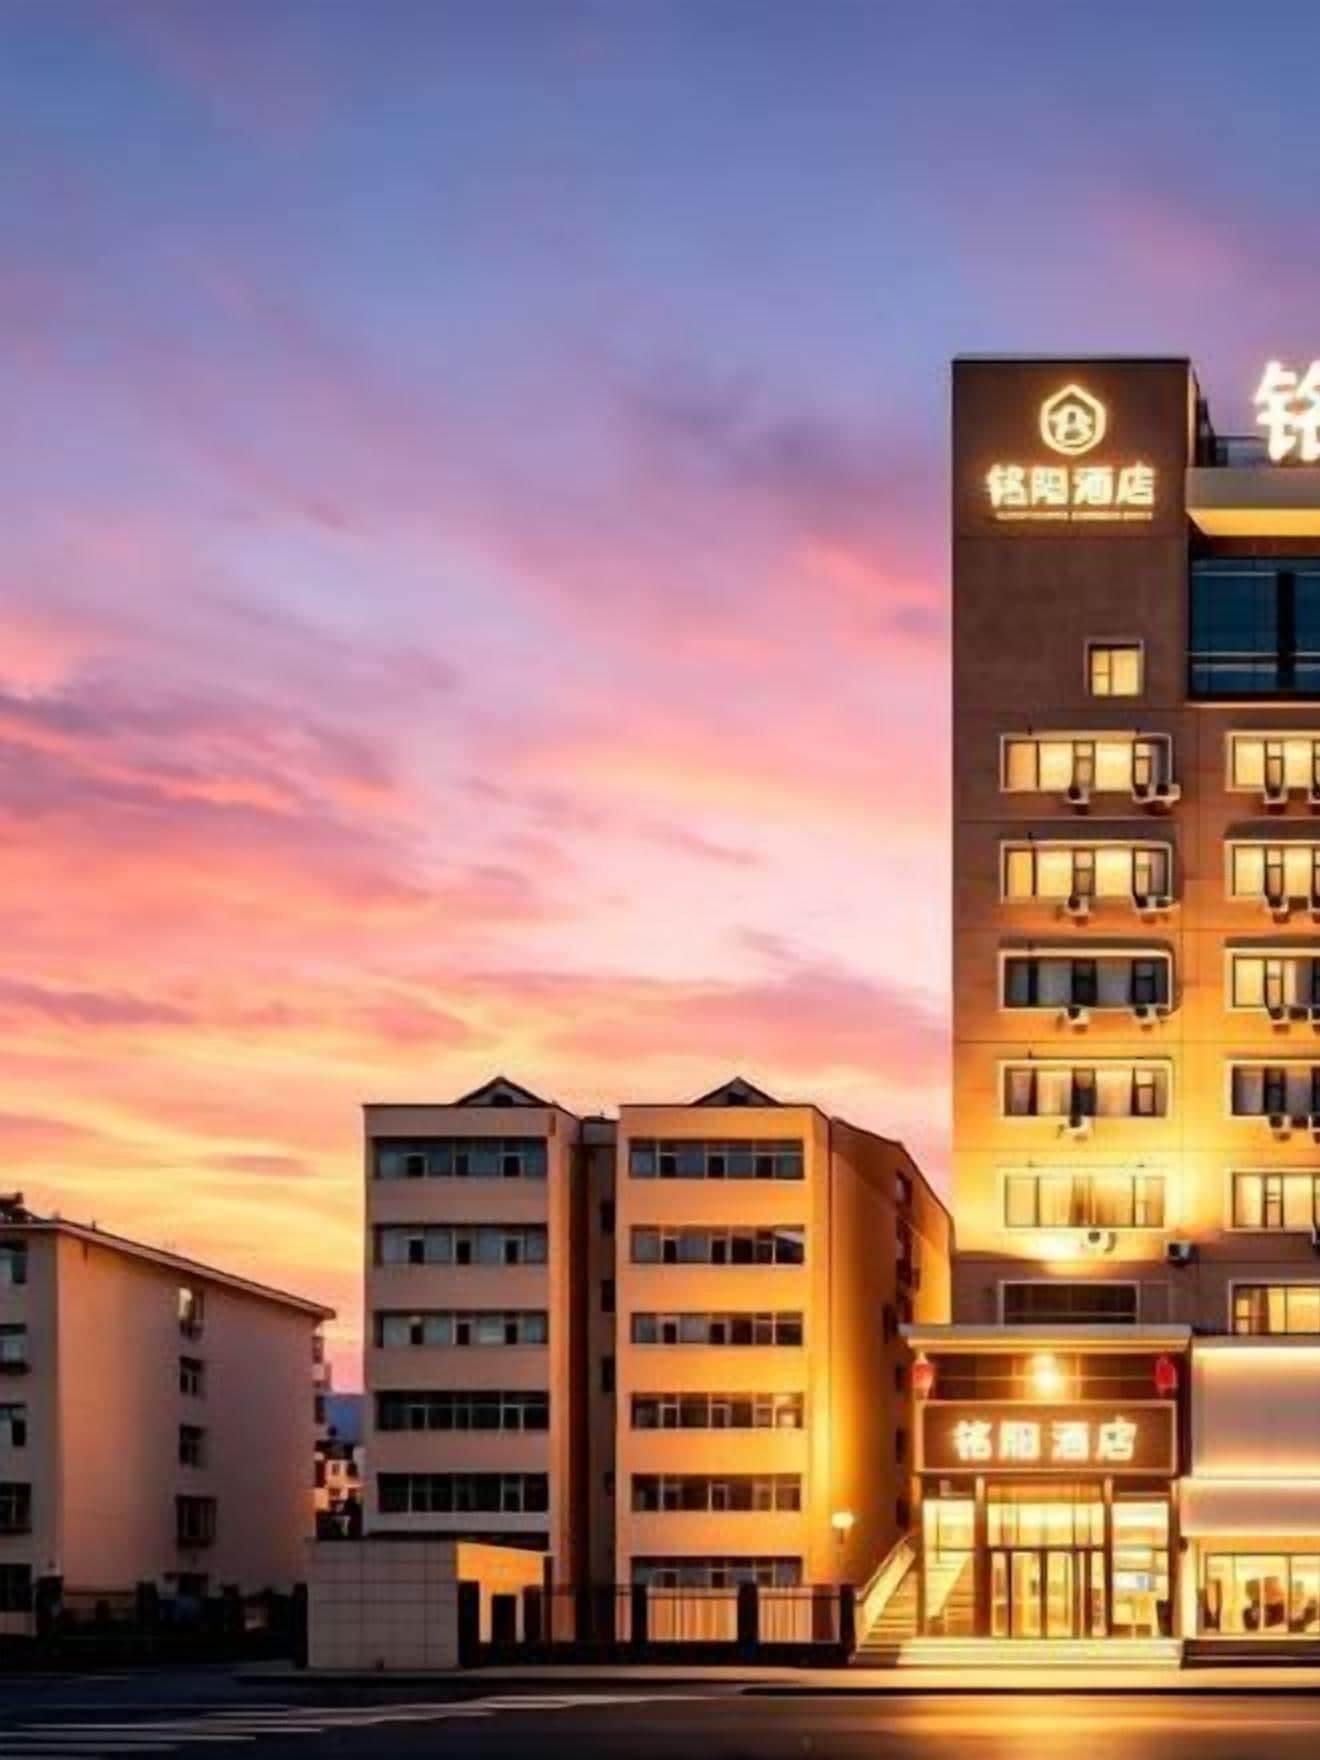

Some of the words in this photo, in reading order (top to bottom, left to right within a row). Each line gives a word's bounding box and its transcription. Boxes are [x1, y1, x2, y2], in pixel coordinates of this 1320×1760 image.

[987, 462, 1156, 507] 铭阳酒店
[954, 1416, 1138, 1460] 铭阳酒店
